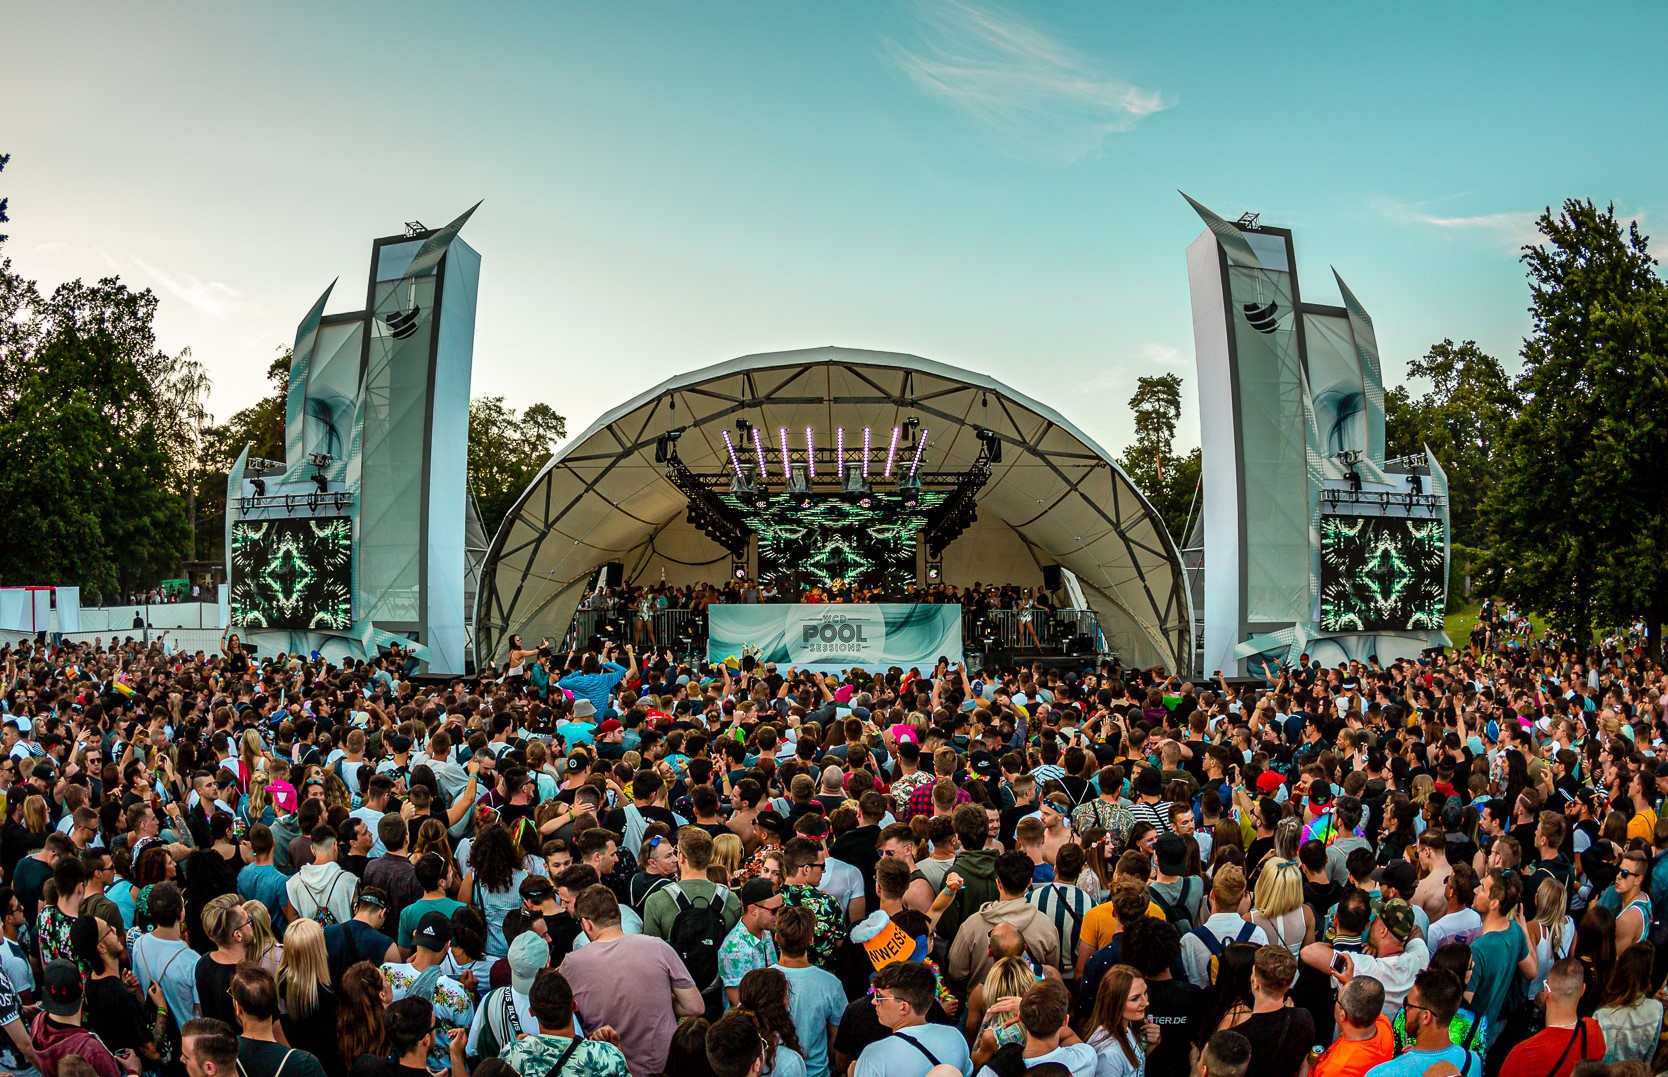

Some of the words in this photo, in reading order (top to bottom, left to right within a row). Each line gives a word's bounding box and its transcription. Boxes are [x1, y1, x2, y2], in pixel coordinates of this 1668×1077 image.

[823, 614, 847, 624] WCD
[802, 624, 868, 643] POOL
[809, 643, 862, 653] SESSIONS
